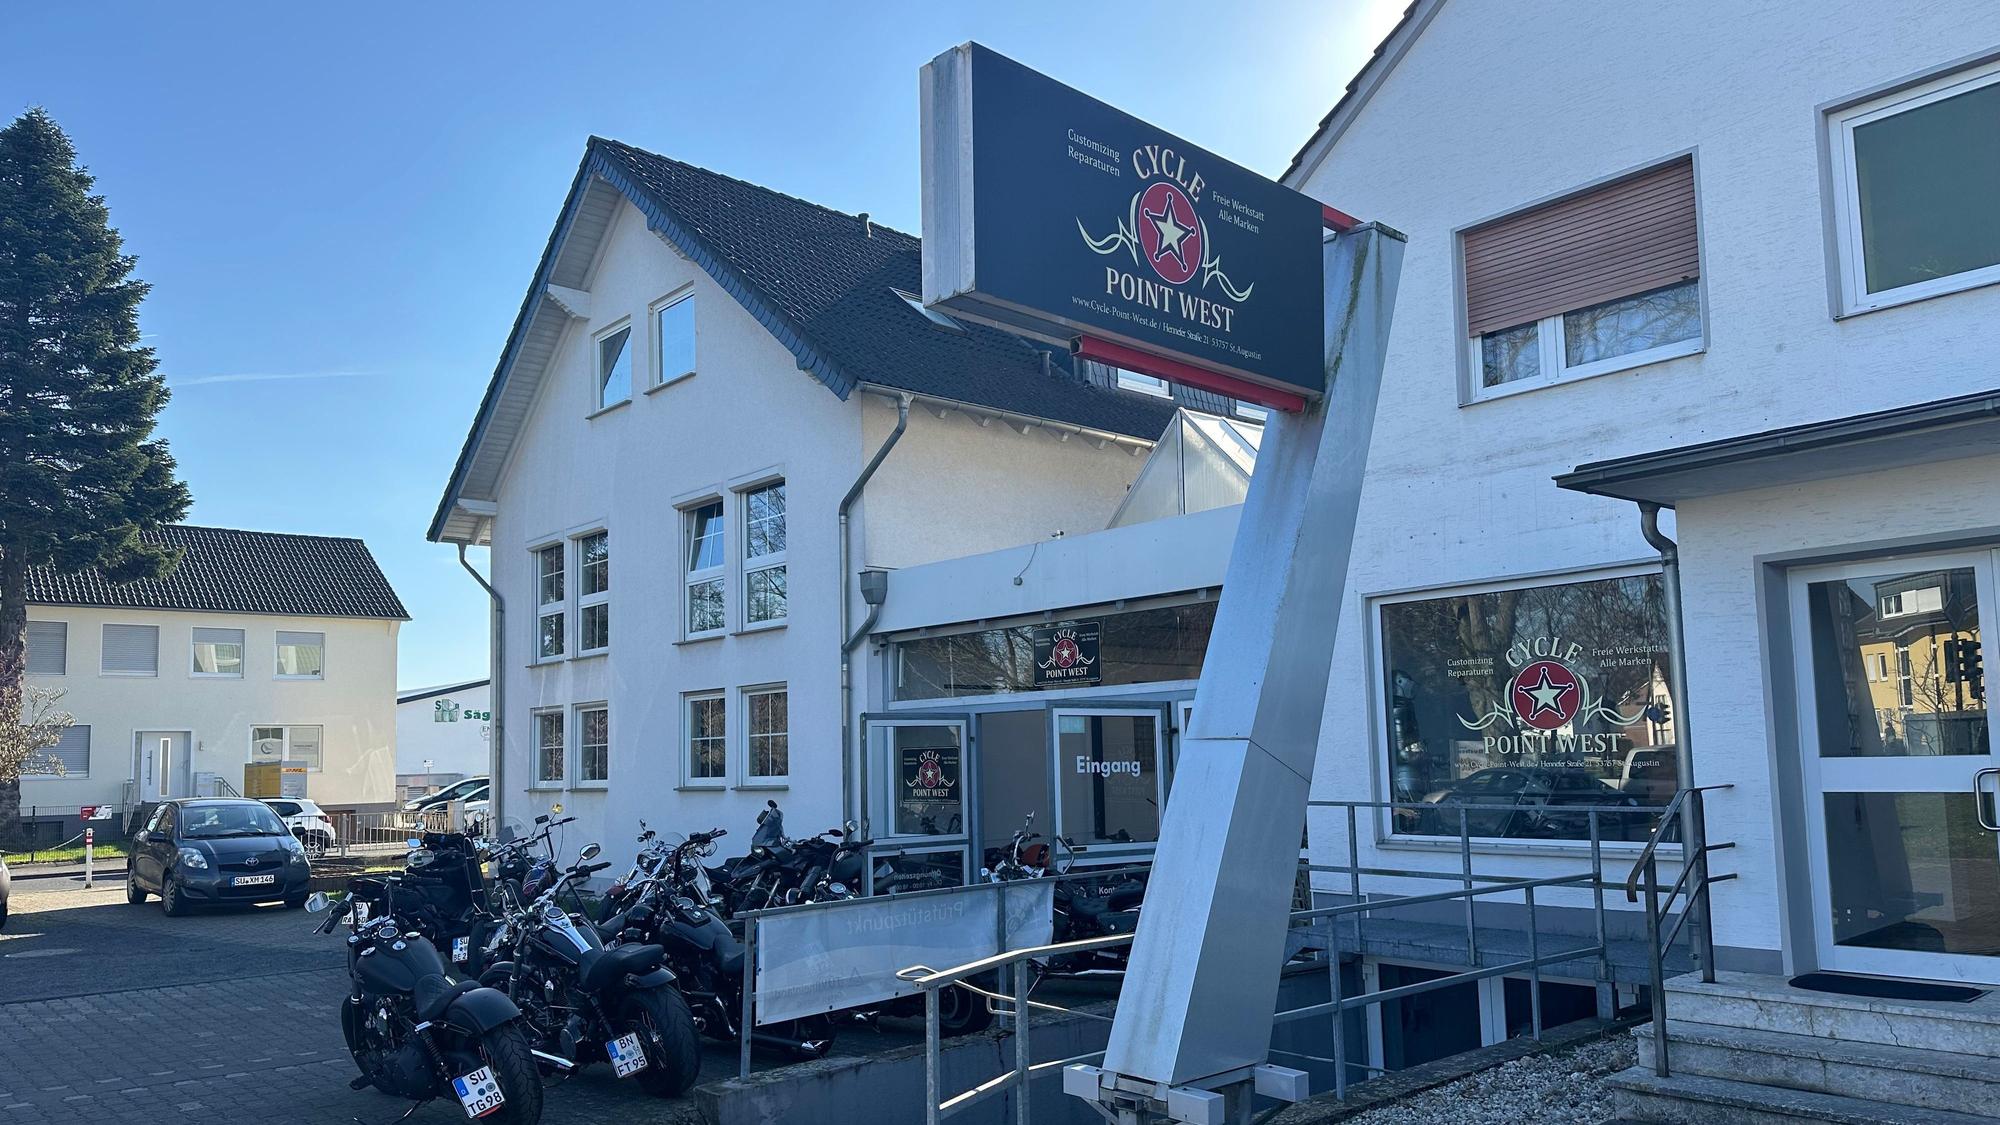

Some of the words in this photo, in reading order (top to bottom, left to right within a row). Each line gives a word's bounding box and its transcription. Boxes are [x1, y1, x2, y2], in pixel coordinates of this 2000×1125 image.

[1068, 128, 1121, 163] Customizing
[1068, 145, 1121, 177] Reparaturen
[1132, 145, 1206, 203] CYCLE
[1212, 191, 1231, 208] Freie
[1231, 197, 1265, 222] Werkstatt
[1218, 209, 1233, 223] Alle
[1233, 217, 1260, 235] Marken
[1106, 266, 1174, 314] POINT
[1178, 291, 1235, 333] WEST
[1071, 296, 1157, 329] www.Cycle-Point-West.de
[1211, 338, 1229, 350] 53757
[1053, 629, 1078, 643] CYCLE
[1505, 636, 1584, 668] CYCLE
[1592, 647, 1614, 657] Freie
[1615, 645, 1659, 656] Werkstatt
[1447, 656, 1493, 668] Customizing
[1600, 658, 1618, 668] Alle
[1618, 657, 1652, 667] Marken
[1046, 669, 1067, 678] POINT
[1068, 667, 1088, 676] WEST
[1447, 667, 1494, 678] Reparaturen
[1483, 735, 1550, 755] POINT
[1555, 733, 1622, 754] WEST
[919, 750, 940, 763] CYCLE
[1076, 755, 1141, 778] Eingang
[912, 789, 931, 797] POINT
[931, 789, 949, 797] WEST
[619, 1035, 634, 1049] BN
[469, 1069, 488, 1085] SU
